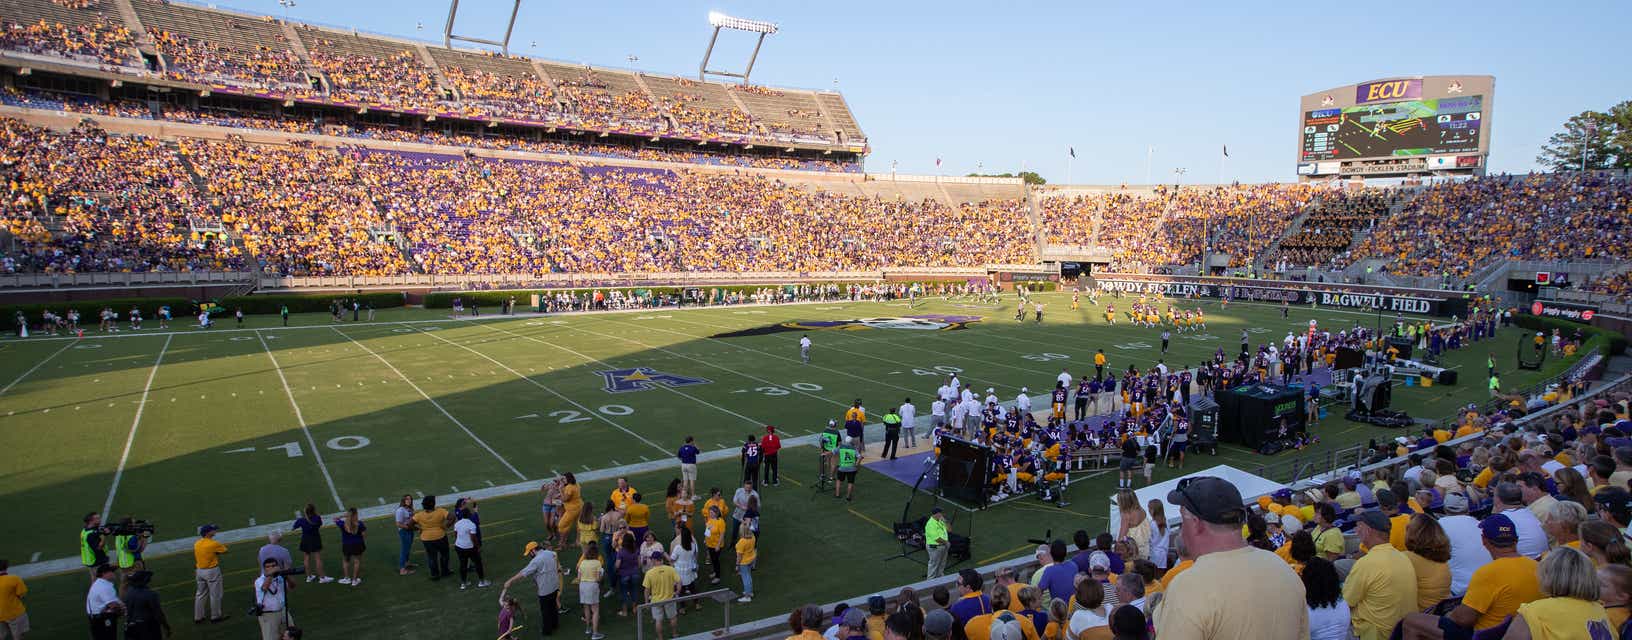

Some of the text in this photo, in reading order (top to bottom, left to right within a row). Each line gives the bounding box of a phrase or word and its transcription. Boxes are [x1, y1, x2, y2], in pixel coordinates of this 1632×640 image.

[1367, 80, 1409, 100] ECU
[1391, 298, 1430, 313] FIELD
[549, 404, 634, 424] 20
[747, 446, 758, 457] 45
